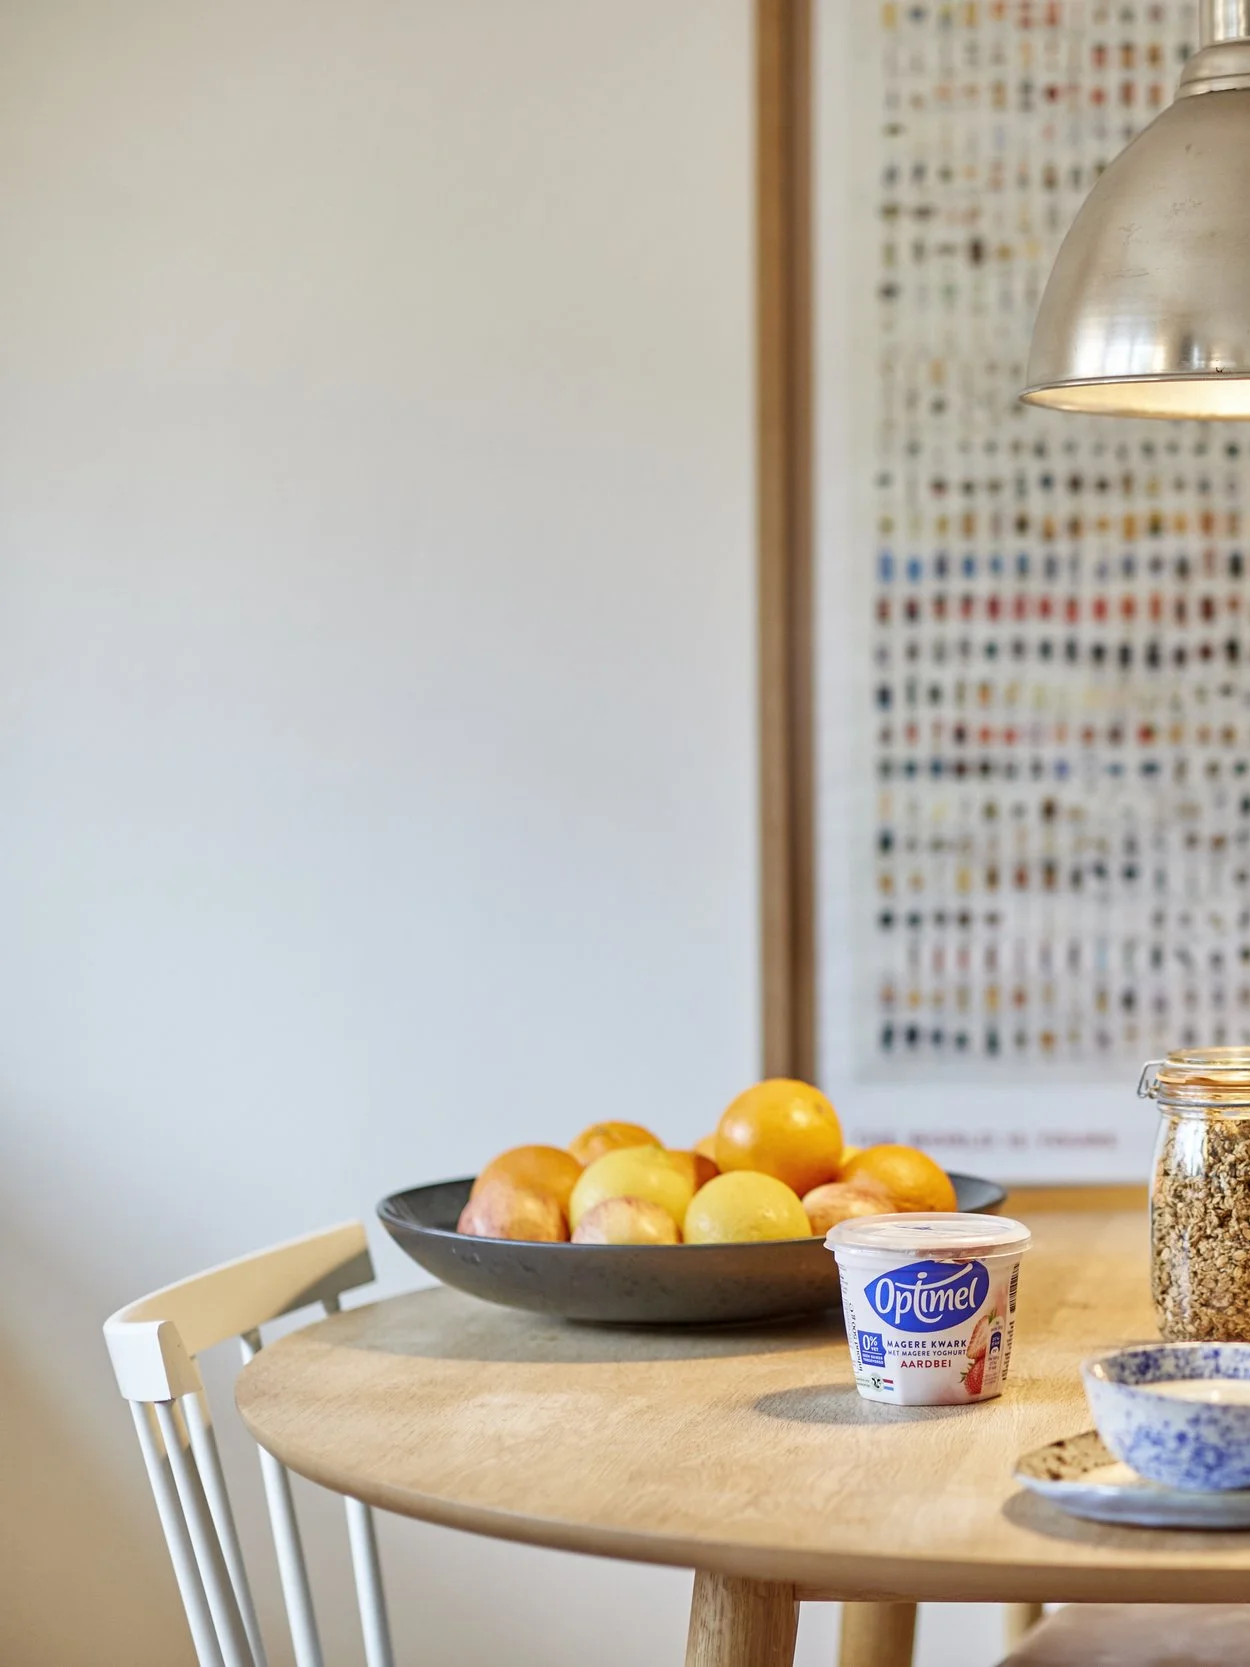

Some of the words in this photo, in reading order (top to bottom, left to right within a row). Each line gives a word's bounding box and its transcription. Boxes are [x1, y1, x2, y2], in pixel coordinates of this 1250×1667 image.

[875, 1263, 978, 1324] Optimel
[862, 1334, 877, 1350] 0%
[887, 1340, 926, 1349] MAGERE
[931, 1339, 967, 1348] KWARK
[901, 1359, 952, 1368] AARDBEI
